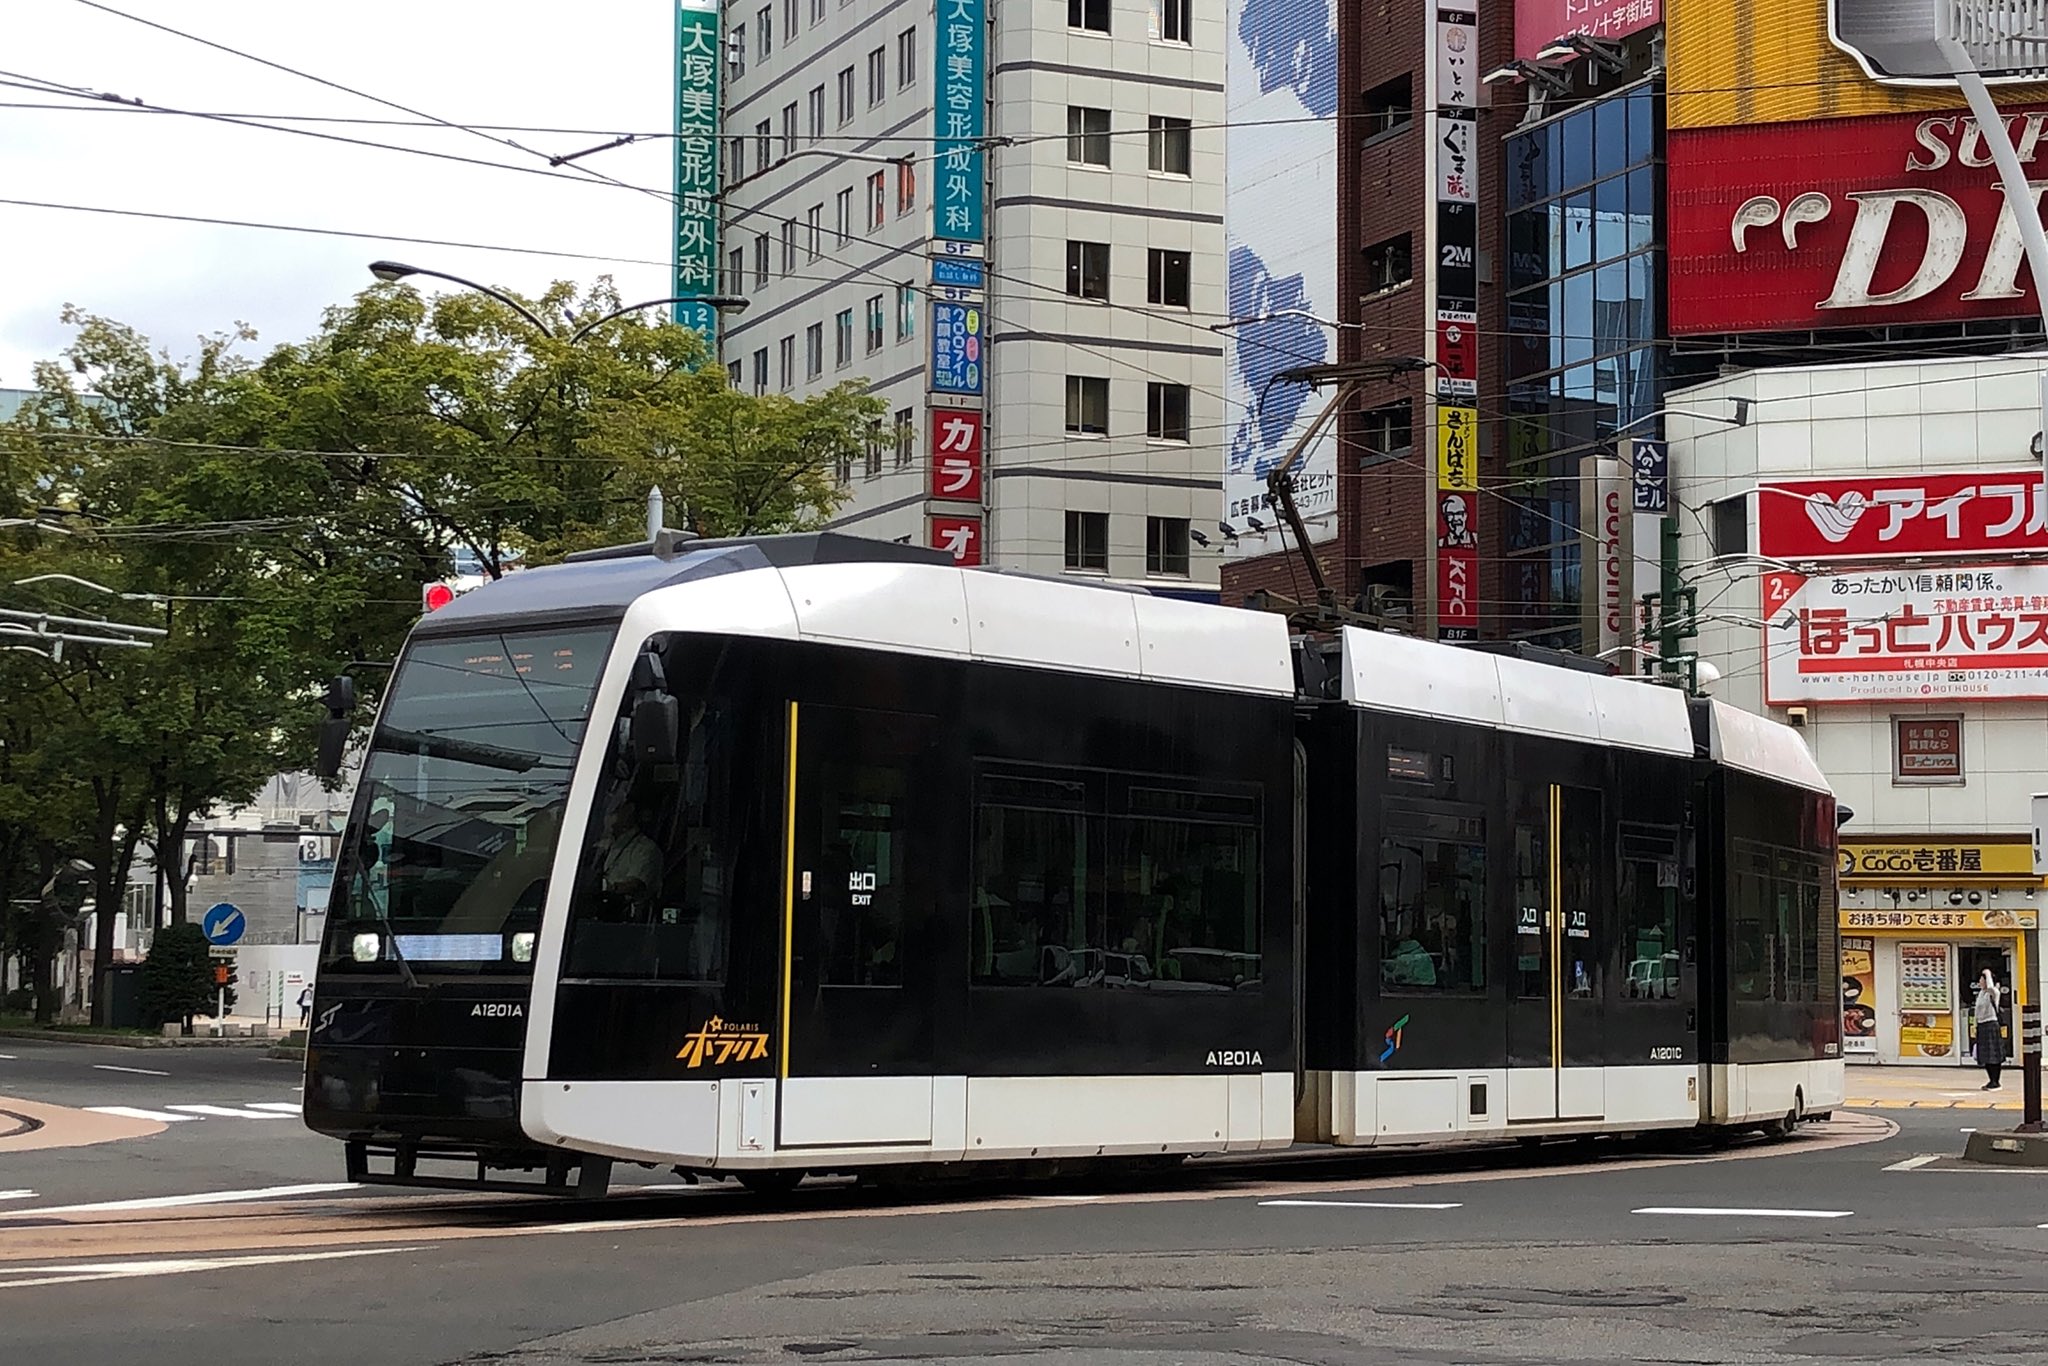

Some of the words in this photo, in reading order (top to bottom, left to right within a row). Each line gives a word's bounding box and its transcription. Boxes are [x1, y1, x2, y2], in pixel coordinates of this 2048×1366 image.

[1449, 14, 1463, 23] 6F
[944, 0, 974, 232] 大塚美容形成外科
[680, 22, 715, 286] 大塚美容形成外科
[1449, 205, 1463, 214] 4F
[945, 242, 972, 255] 5F
[1442, 245, 1472, 267] 2M
[944, 287, 972, 300] 5F
[1449, 301, 1463, 310] 3F
[1449, 556, 1466, 617] KFC
[1770, 578, 1790, 600] 2F
[1831, 572, 2003, 595] あったかい信頼関係。
[849, 871, 876, 891] 出口
[852, 894, 872, 905] EXIT
[1521, 907, 1537, 923] 入口
[1571, 911, 1587, 926] 入口
[470, 1004, 523, 1017] A1201A
[1206, 1051, 1263, 1065] A1201A
[1650, 1047, 1683, 1059] A1201C
